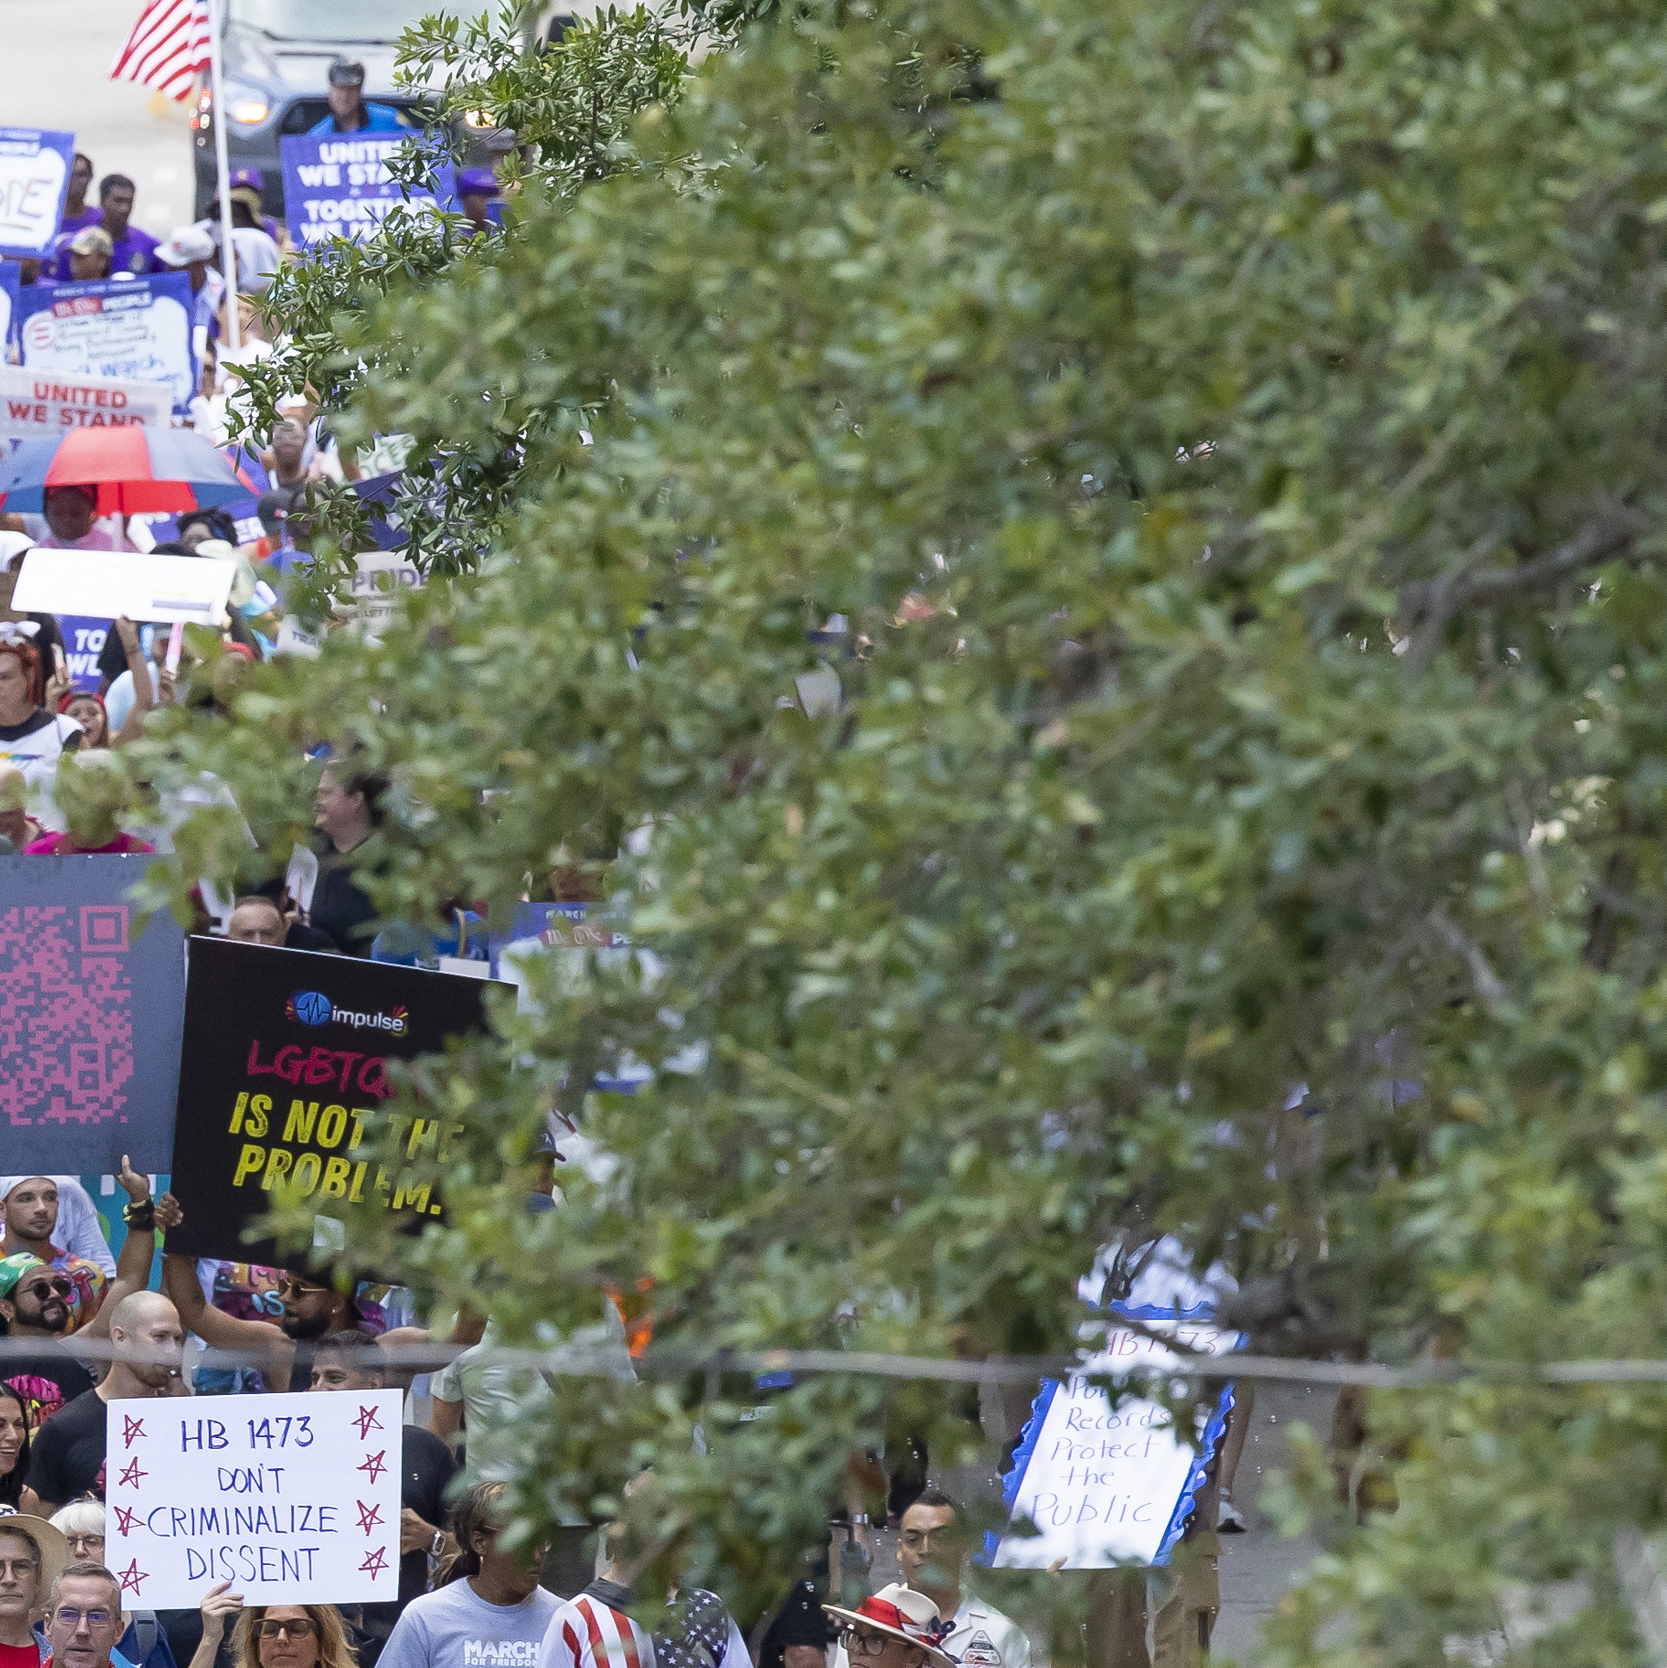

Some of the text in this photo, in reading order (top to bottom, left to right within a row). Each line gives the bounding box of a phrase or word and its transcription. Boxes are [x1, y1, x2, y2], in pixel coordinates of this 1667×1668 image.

[181, 1416, 315, 1452] HB 1473
[217, 1464, 285, 1494] DON'T
[1061, 1466, 1115, 1488] the
[146, 1505, 339, 1538] CRIMINALIZE
[1031, 1494, 1153, 1527] Public
[187, 1546, 320, 1582] DISSENT
